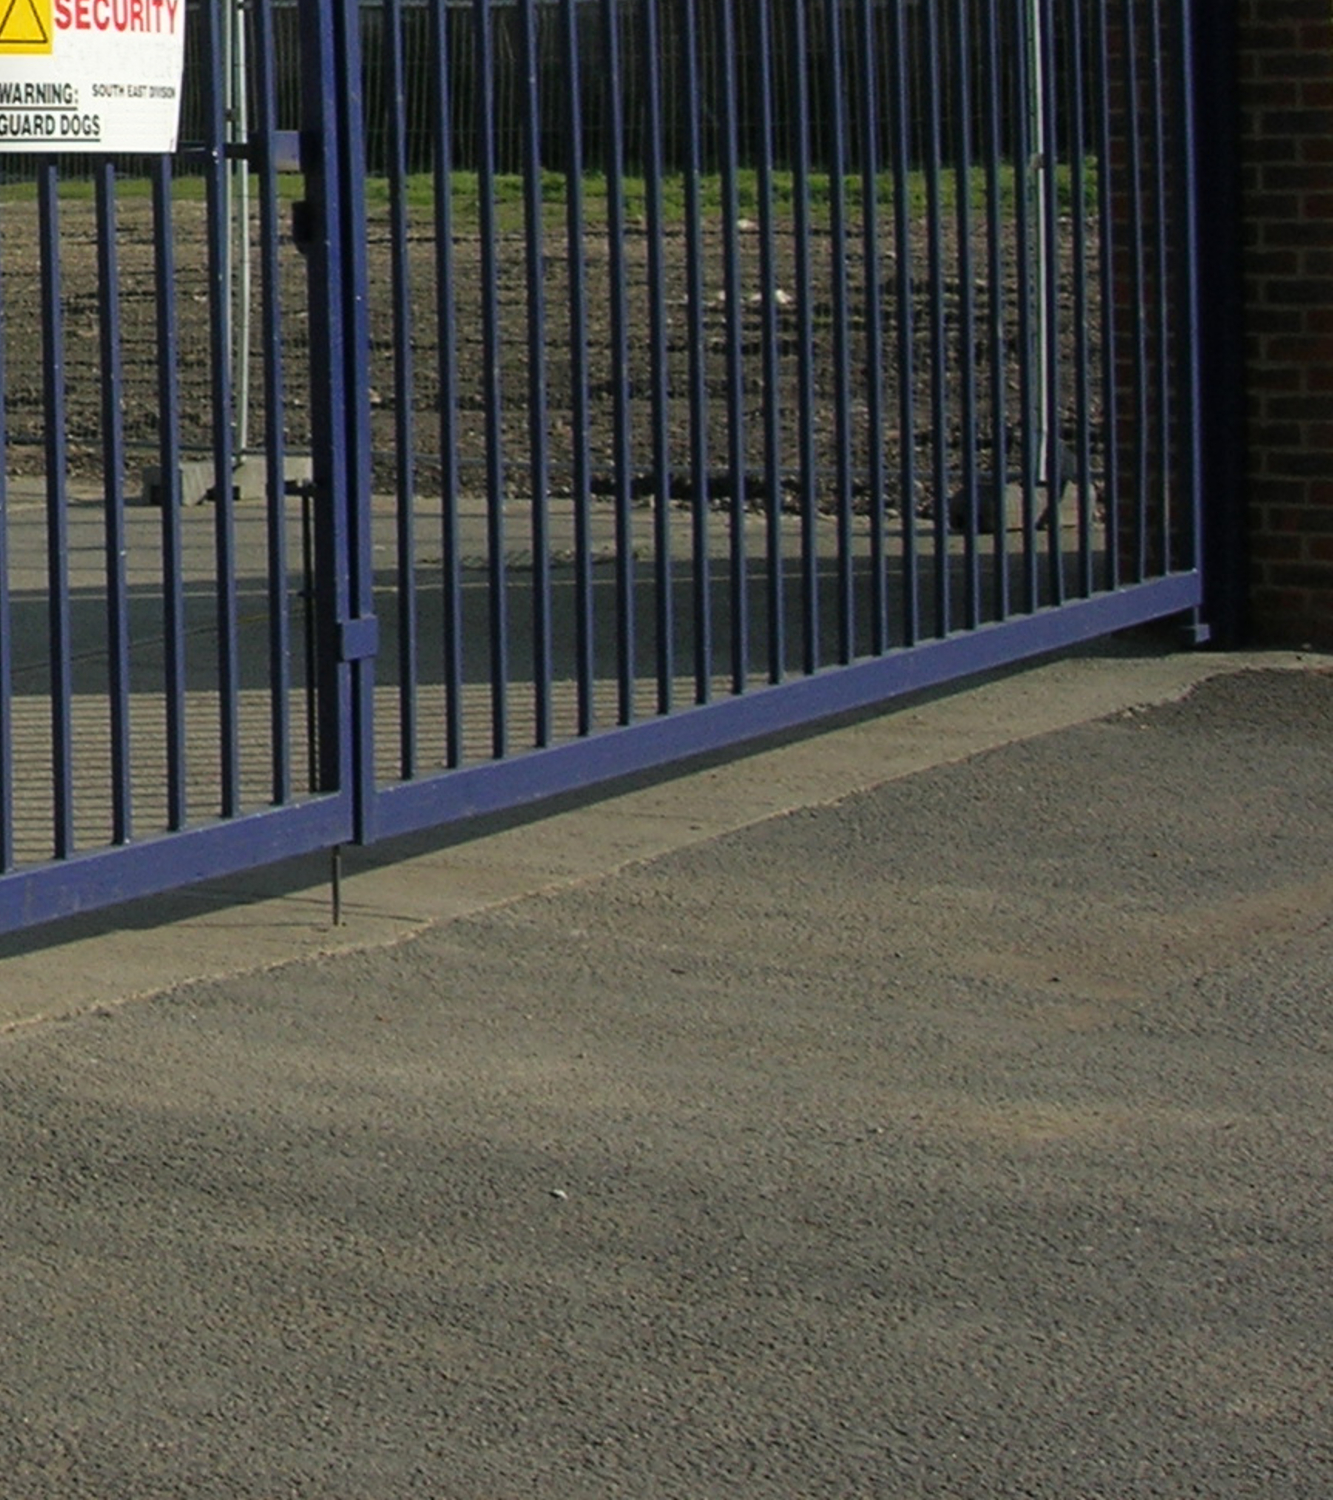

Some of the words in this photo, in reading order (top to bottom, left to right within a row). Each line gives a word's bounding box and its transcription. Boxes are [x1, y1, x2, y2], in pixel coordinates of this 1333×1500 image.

[91, 83, 125, 98] SOUTH
[127, 84, 148, 99] EAST
[60, 114, 101, 136] DOGS
